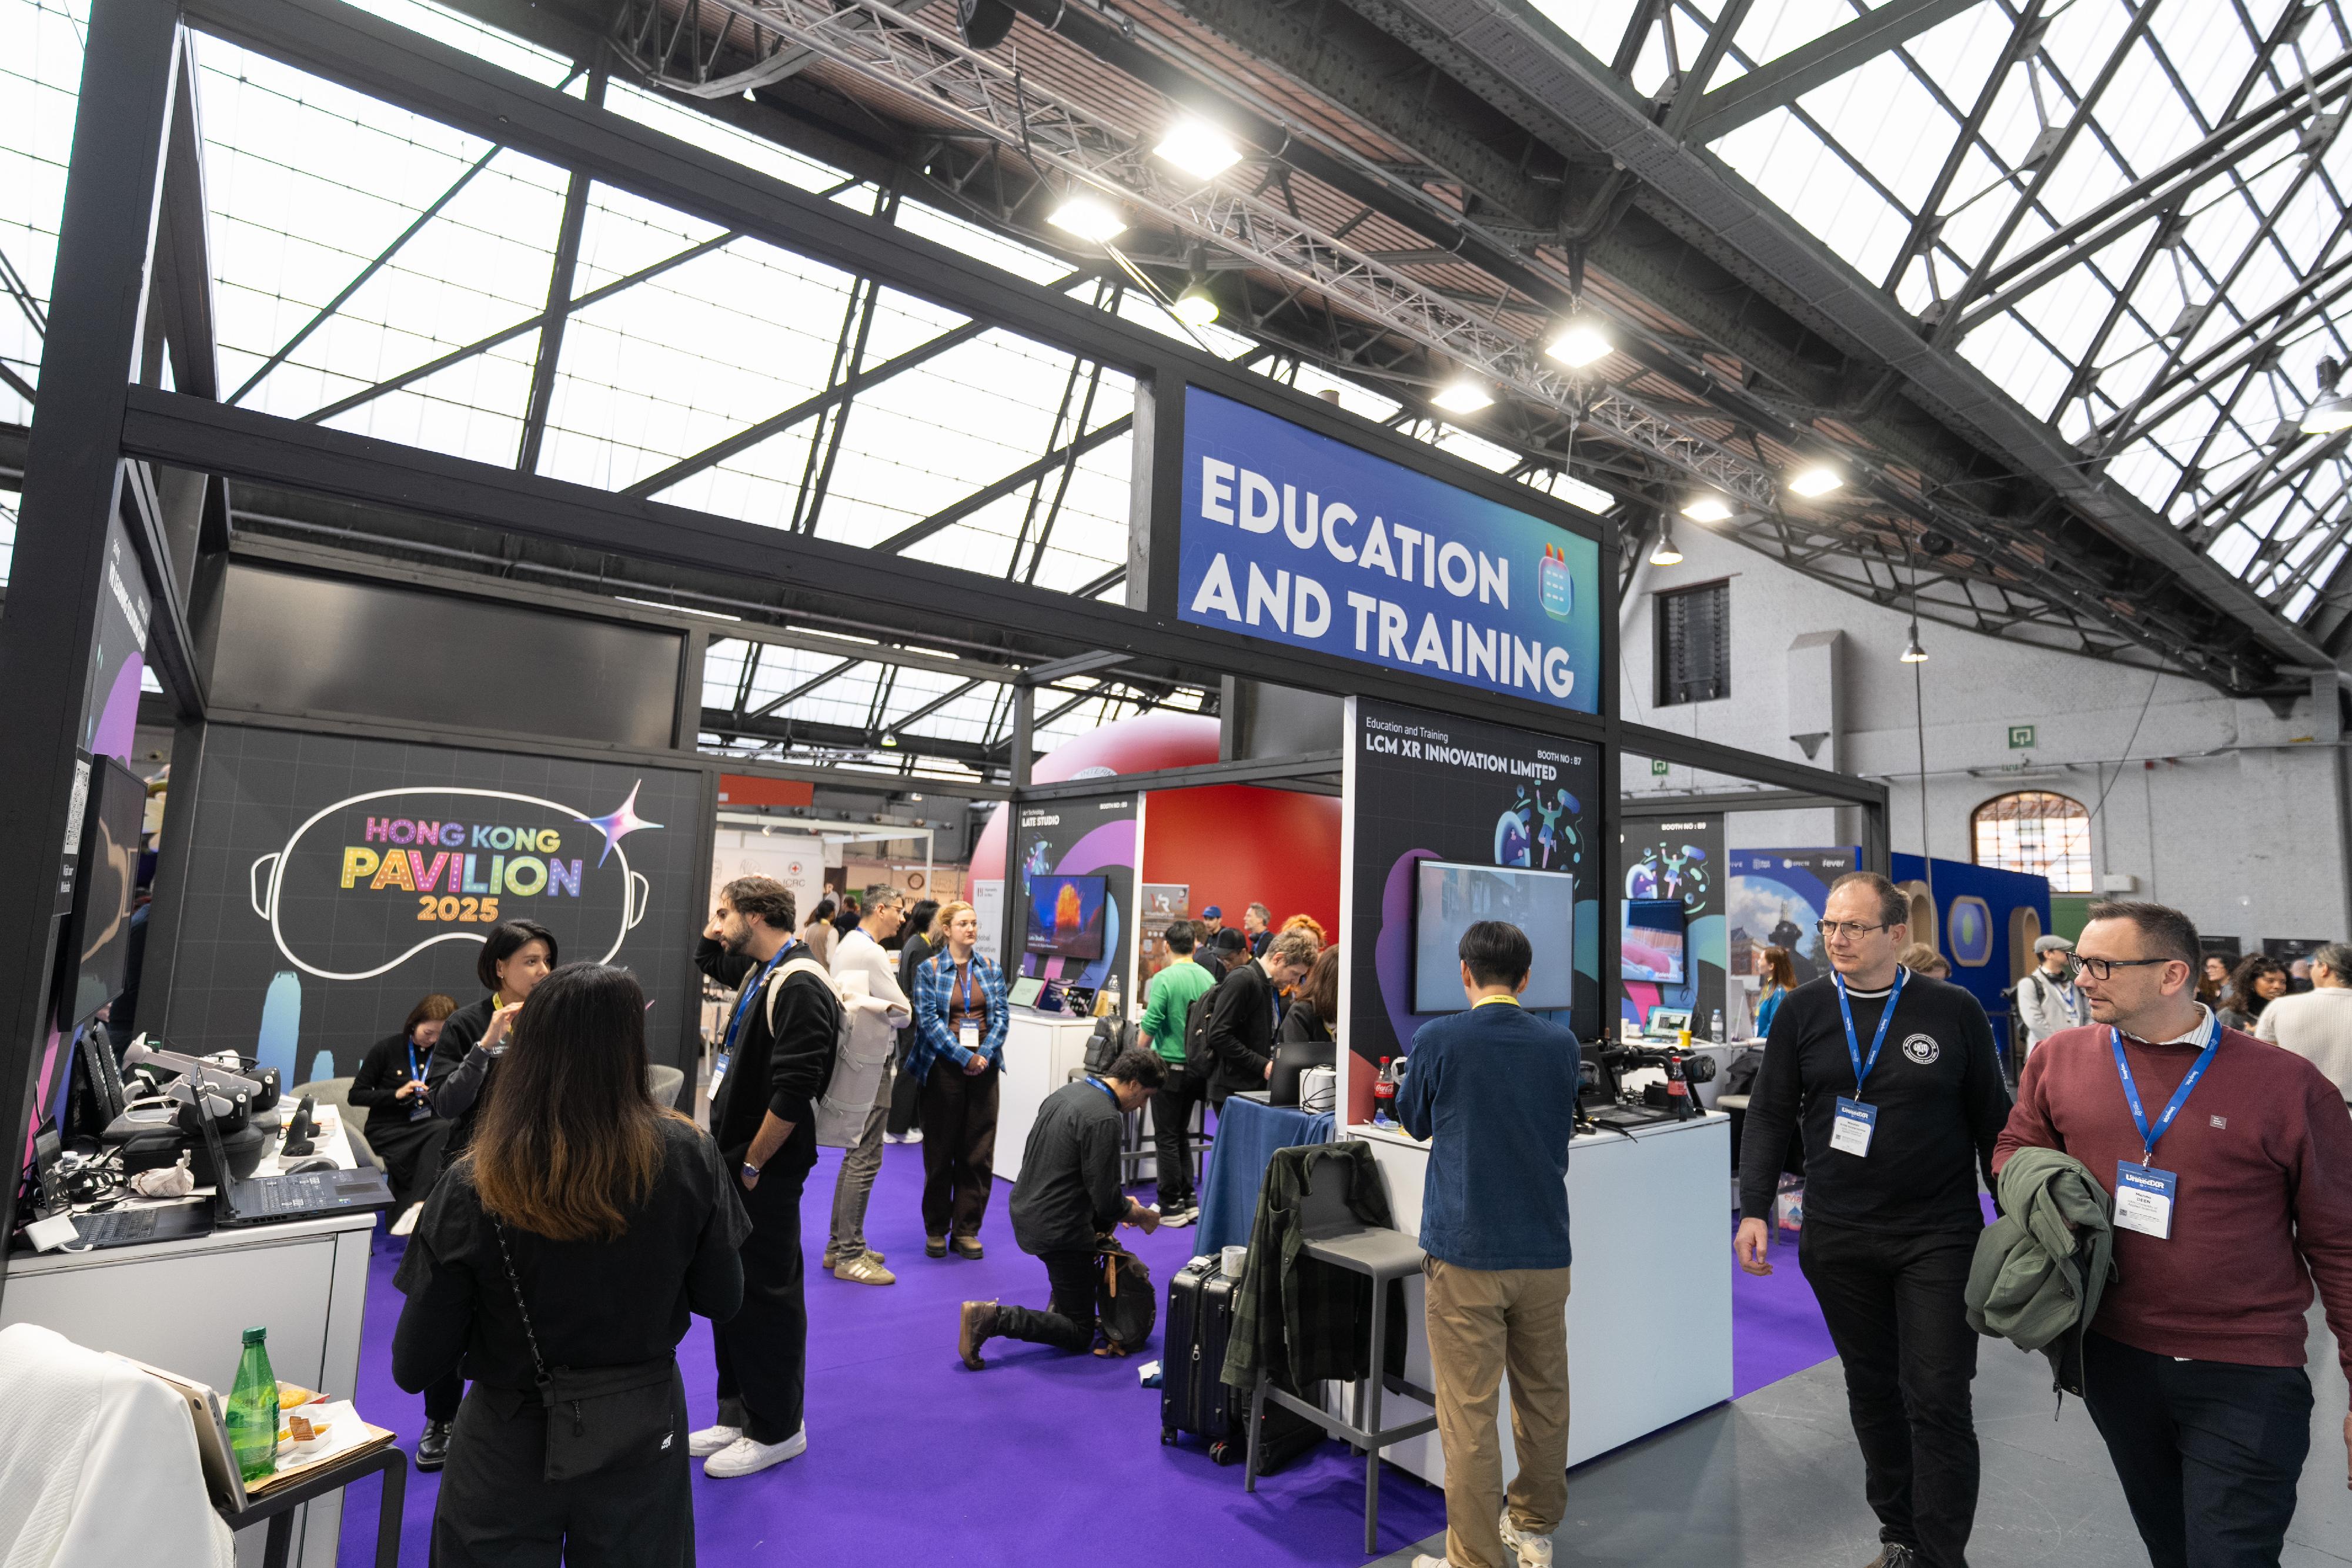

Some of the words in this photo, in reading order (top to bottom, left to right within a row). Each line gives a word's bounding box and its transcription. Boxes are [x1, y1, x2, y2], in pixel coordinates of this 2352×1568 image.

[1201, 456, 1509, 610] EDUCATION
[1191, 553, 1331, 638] AND
[1348, 591, 1575, 699] TRAINING
[1366, 717, 1403, 734] Education
[1404, 726, 1418, 736] and
[1419, 727, 1448, 744] Training
[1366, 733, 1398, 754] LCM
[1401, 740, 1422, 759] XR
[1425, 743, 1508, 773] INNOVATION
[1510, 759, 1557, 781] LIMITED
[1537, 750, 1559, 762] BOOTH
[1560, 754, 1569, 764] NO
[1022, 817, 1036, 827] LATE
[1037, 815, 1060, 826] STUDIO
[365, 817, 465, 847] HONG
[472, 825, 561, 853] KONG
[340, 846, 583, 897] PAVILION
[1823, 859, 1845, 867] fever
[783, 879, 806, 887] ICRC
[417, 895, 499, 922] 2025
[2126, 1174, 2164, 1189] UnitedXR
[1785, 1194, 1802, 1203] evia
